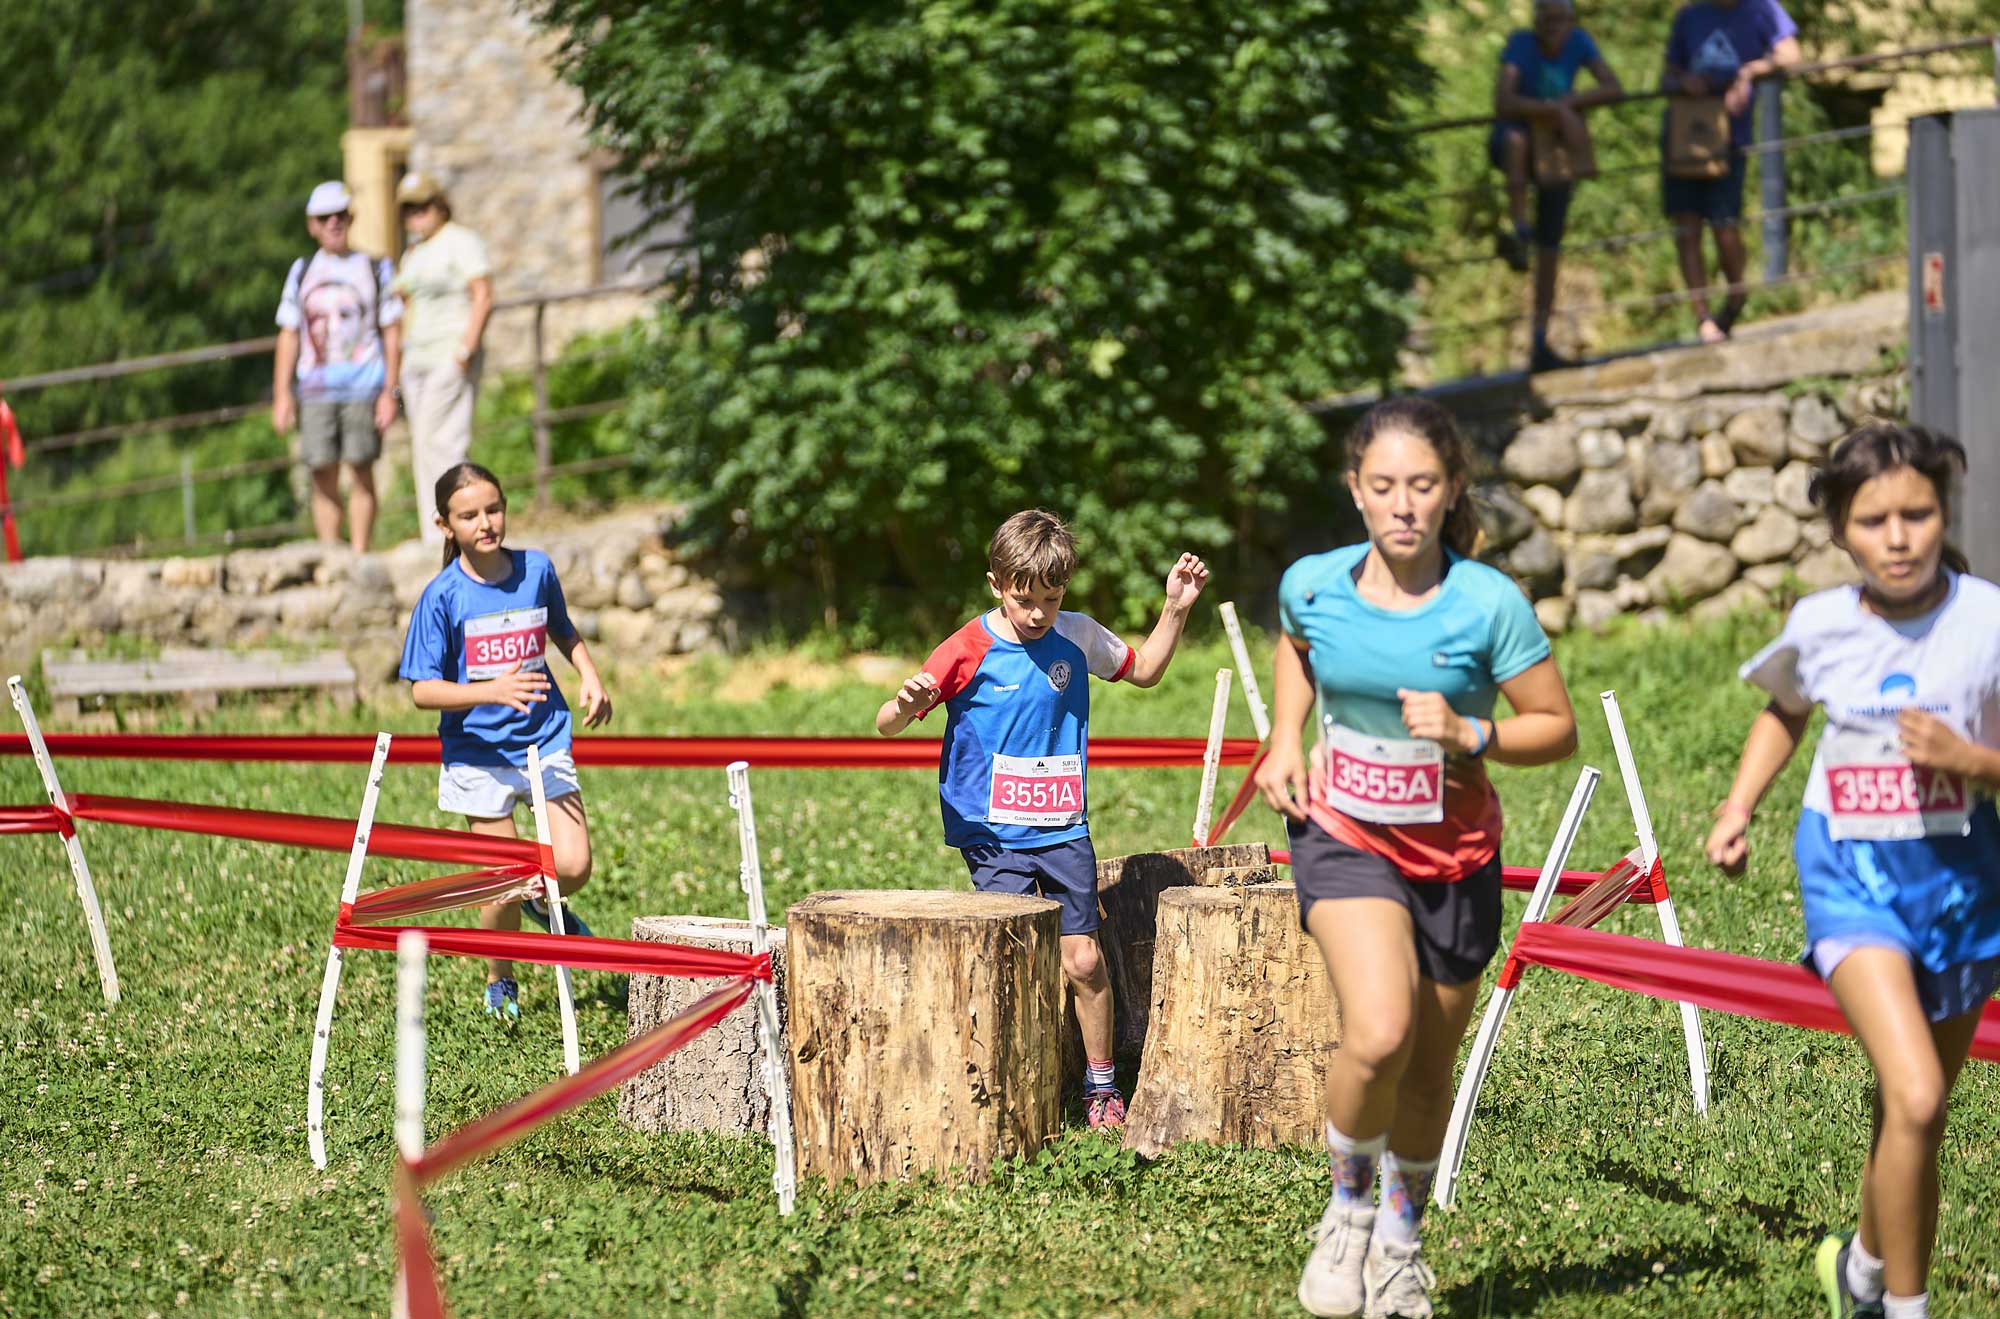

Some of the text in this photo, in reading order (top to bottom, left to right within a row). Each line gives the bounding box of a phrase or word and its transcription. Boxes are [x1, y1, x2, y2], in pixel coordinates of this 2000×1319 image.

[476, 632, 539, 663] 3561A
[1000, 780, 1077, 808] 3551A
[1335, 754, 1433, 802] 3555A
[1834, 769, 1958, 812] 3556A
